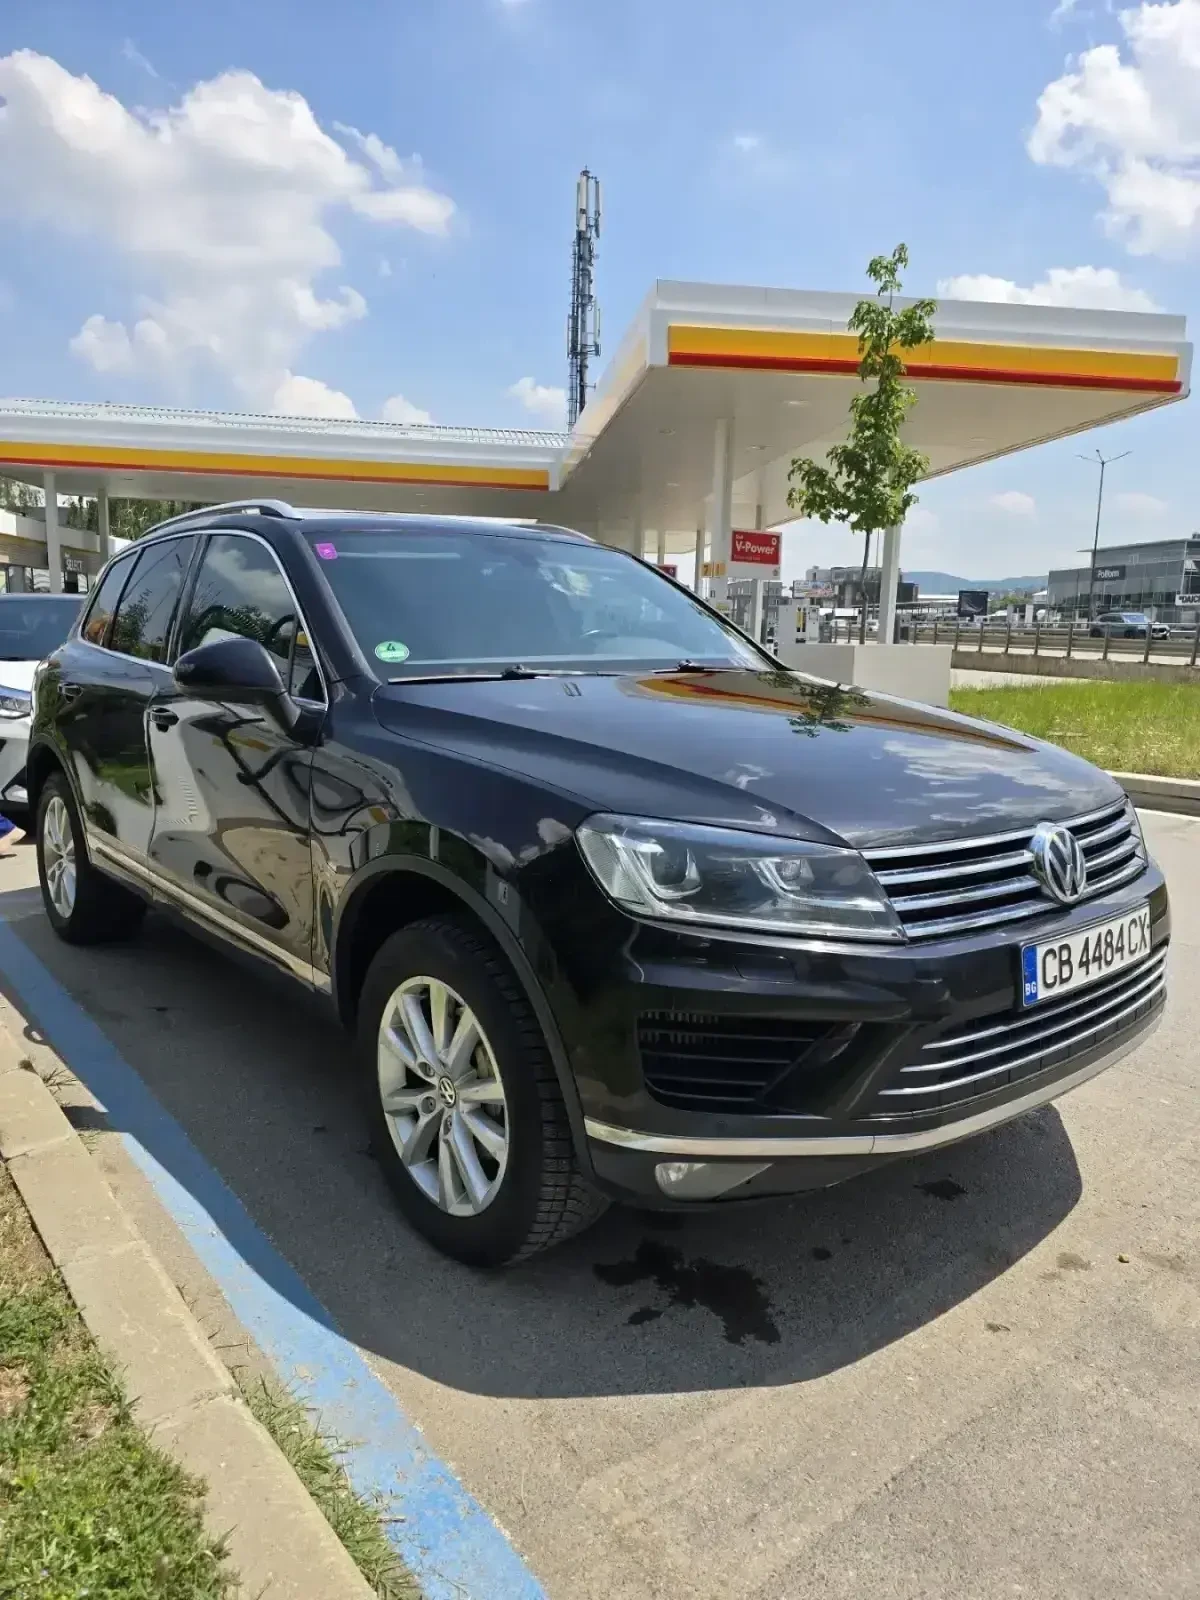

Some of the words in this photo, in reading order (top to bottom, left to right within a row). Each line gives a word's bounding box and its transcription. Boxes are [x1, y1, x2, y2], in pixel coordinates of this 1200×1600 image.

[735, 540, 775, 555] V-Power
[1042, 943, 1073, 989] CB
[1078, 923, 1125, 976] 4484
[1128, 912, 1148, 955] CX
[1025, 981, 1037, 996] BG
